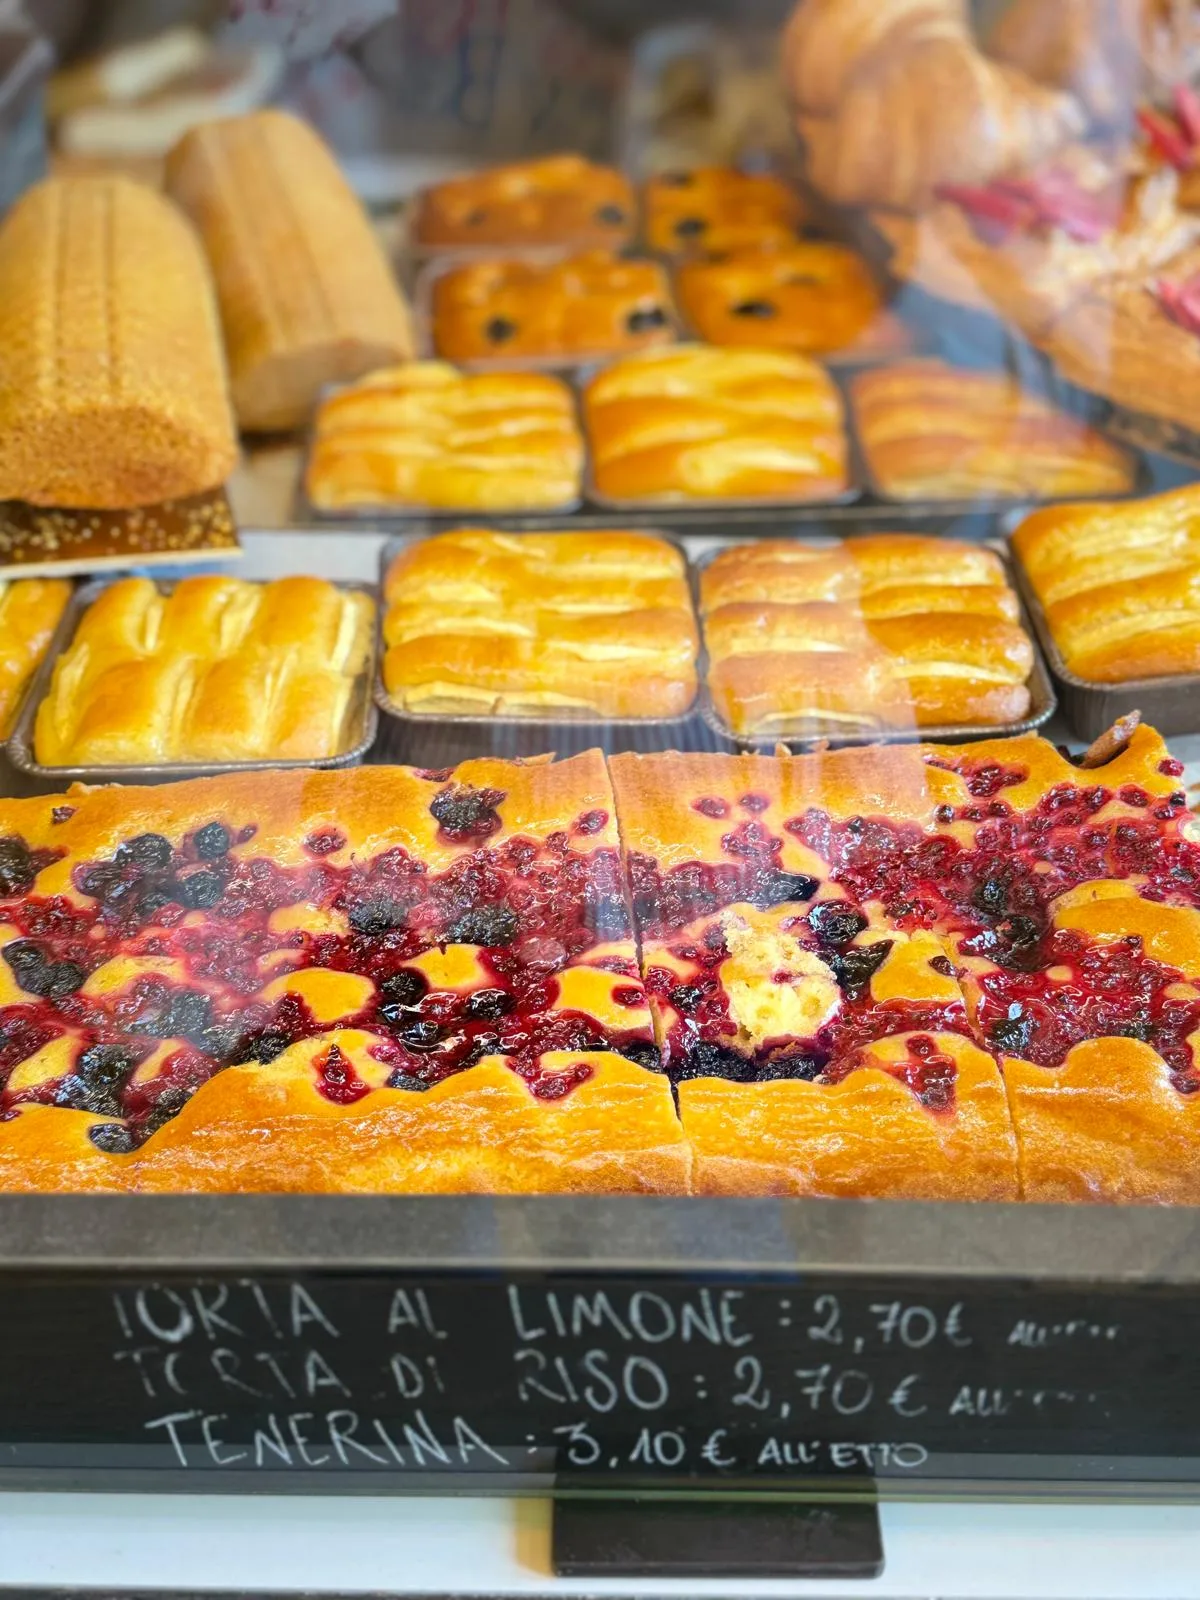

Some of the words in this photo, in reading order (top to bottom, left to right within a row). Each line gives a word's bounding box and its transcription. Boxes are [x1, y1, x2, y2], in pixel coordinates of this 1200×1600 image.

[387, 1289, 447, 1339] AL
[508, 1284, 753, 1346] LIMONE
[513, 1349, 669, 1412] RISO
[144, 1408, 510, 1466] TENERINA
